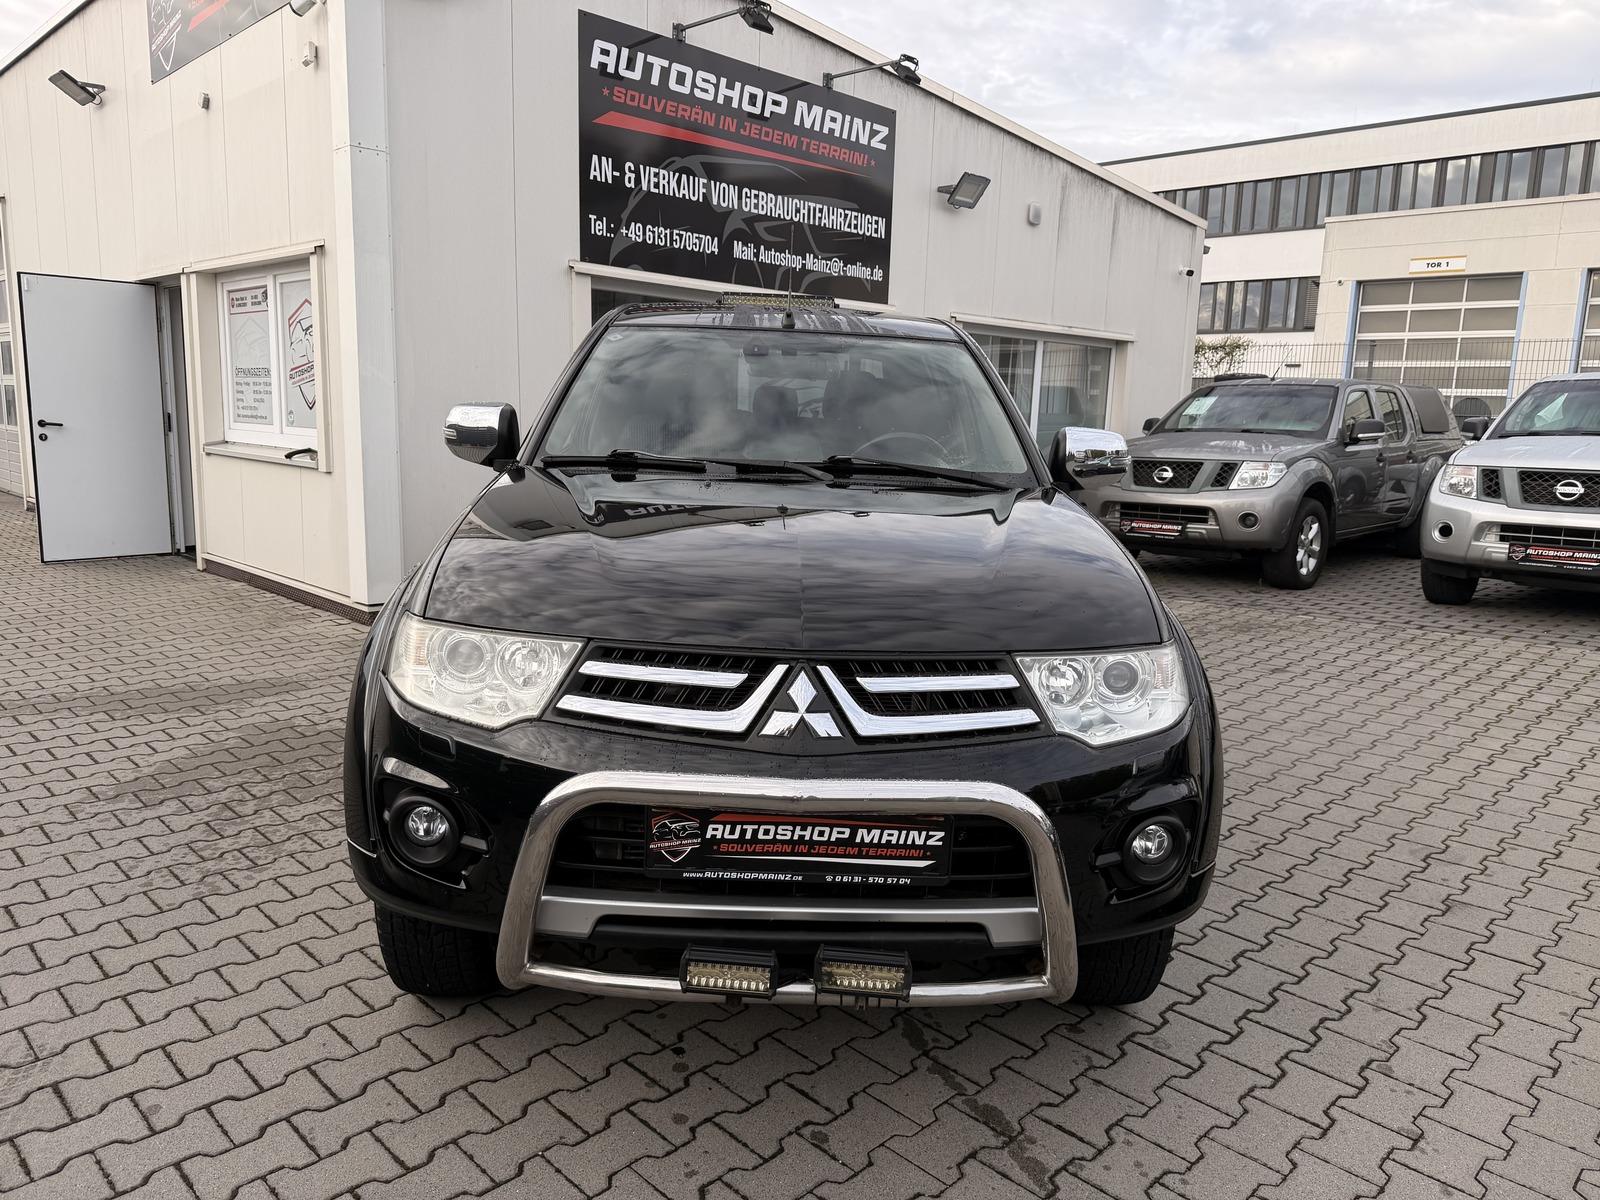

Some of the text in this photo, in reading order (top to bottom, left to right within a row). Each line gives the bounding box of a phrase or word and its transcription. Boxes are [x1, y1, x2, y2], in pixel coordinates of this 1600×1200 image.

[590, 39, 889, 150] AUTOSHOP MAINZ
[612, 87, 869, 167] SOUVERÄN IN JEDEM TERRAIN!
[589, 154, 886, 239] AN- & VERKAUF VON GEBRAUCHTFAHRZEUGEN
[589, 214, 719, 255] Tel.: +49 6131 5705704
[733, 240, 883, 282] Mail: Autoshop-Mainz@t-online.de
[1526, 548, 1573, 557] AUTOSHOP
[649, 840, 681, 849] AUTOSHOP
[705, 824, 945, 846] AUTOSHOP MAINZ
[719, 843, 793, 853] SOUVERÄN
[794, 845, 808, 853] IN
[811, 845, 859, 855] JEDEM
